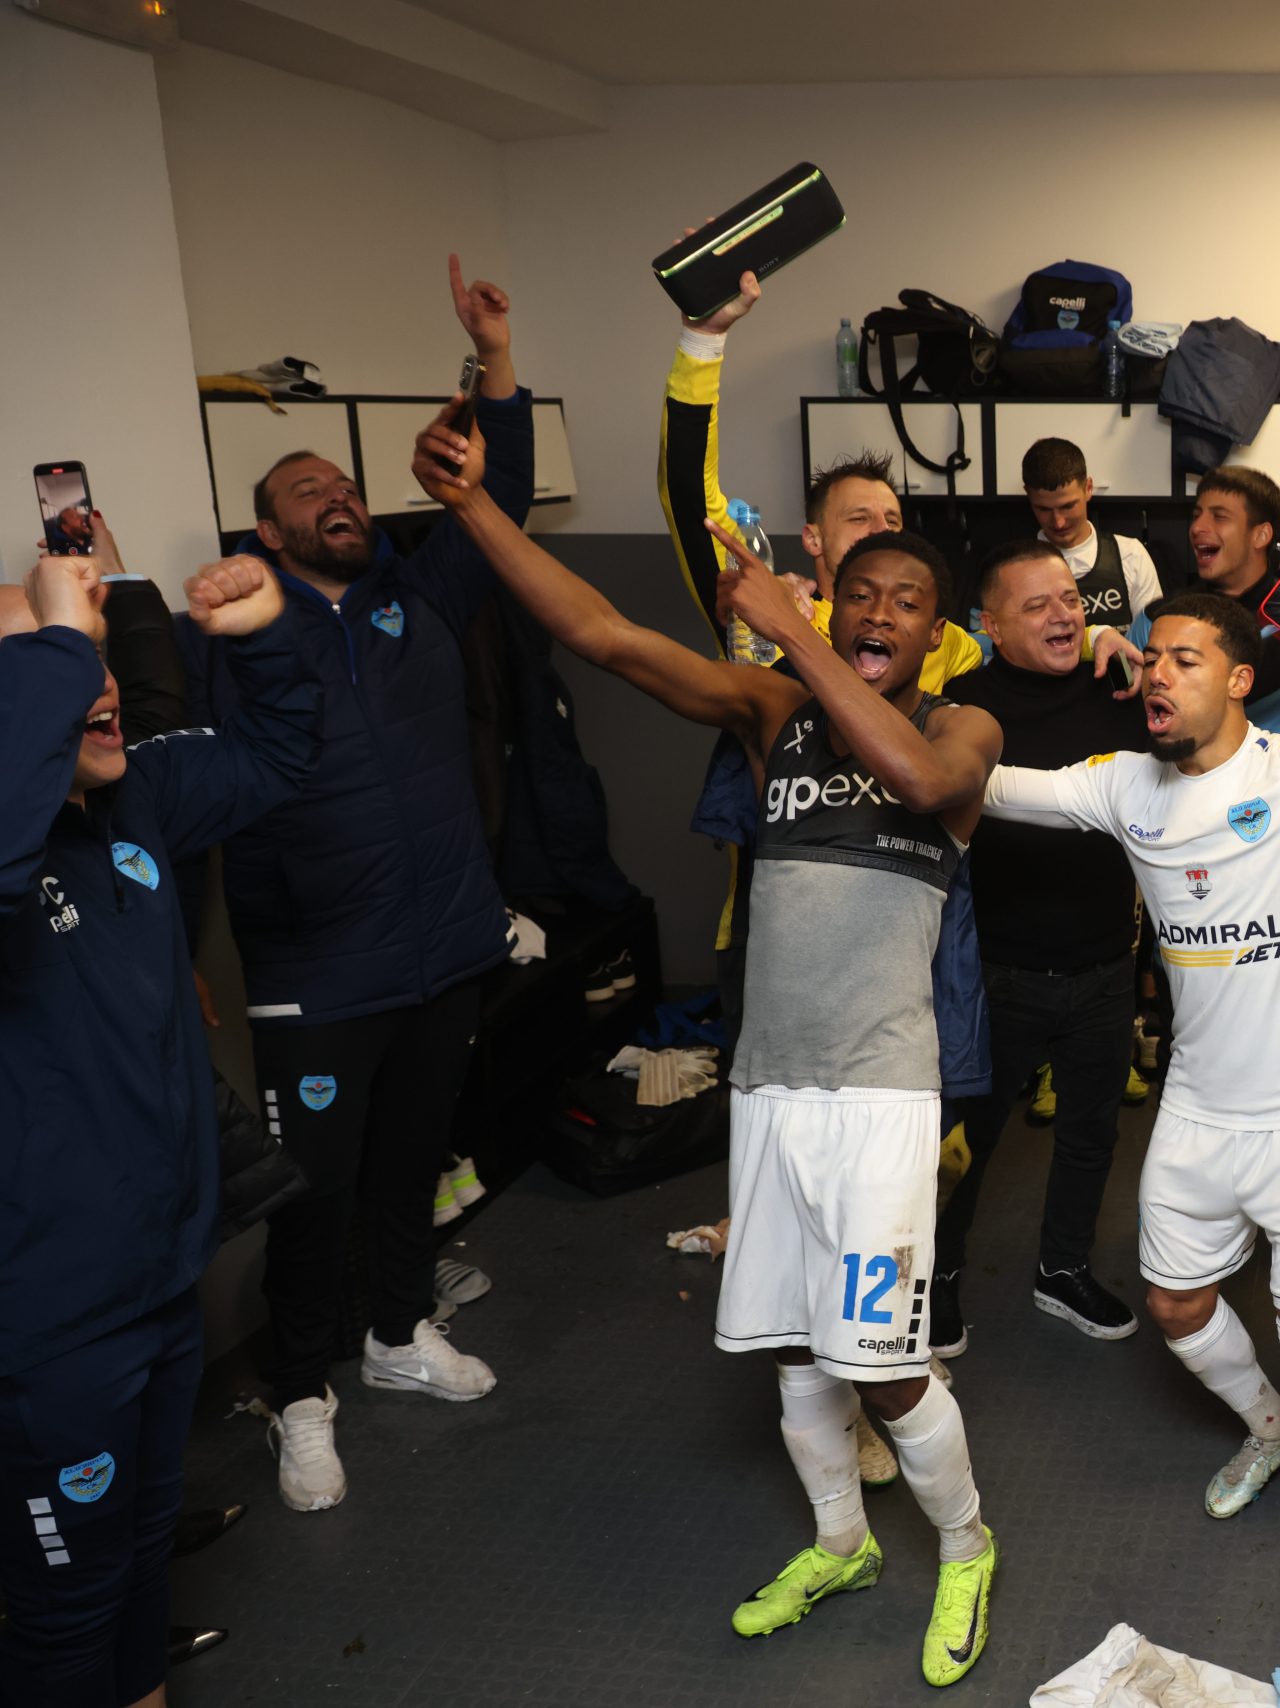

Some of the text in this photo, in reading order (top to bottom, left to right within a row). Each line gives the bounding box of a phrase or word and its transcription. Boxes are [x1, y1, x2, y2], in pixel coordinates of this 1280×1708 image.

[1049, 297, 1086, 310] capelli
[876, 834, 943, 862] THE POWER TRACKER
[842, 1253, 898, 1324] 12
[858, 1336, 905, 1353] capelli
